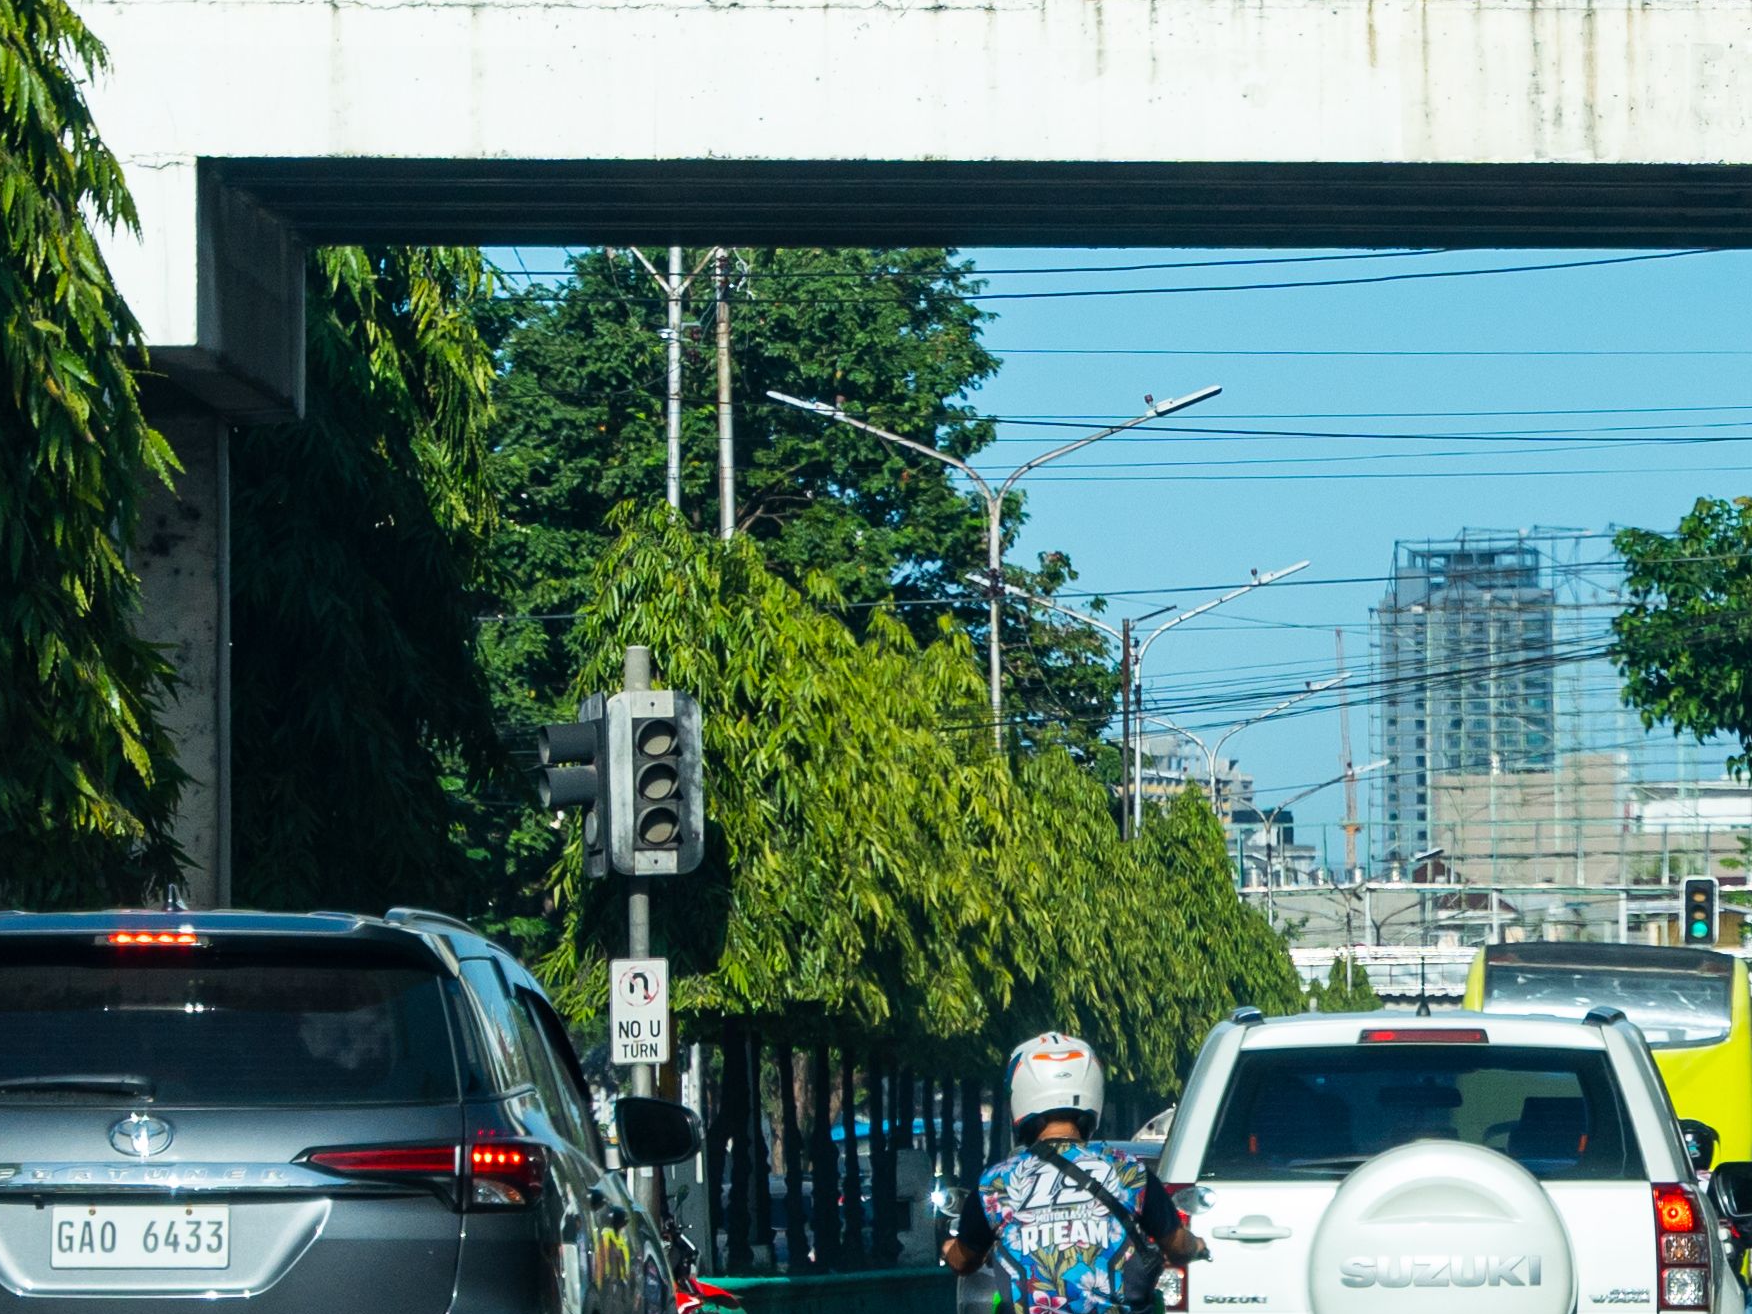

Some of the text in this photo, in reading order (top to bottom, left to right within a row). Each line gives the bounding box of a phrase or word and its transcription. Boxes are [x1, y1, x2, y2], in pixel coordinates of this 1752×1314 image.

[618, 1019, 661, 1040] NO U
[621, 1042, 659, 1059] TURN
[142, 1219, 225, 1255] 6433
[1021, 1220, 1109, 1256] RTEAM
[1339, 1253, 1543, 1289] SUZUKI
[1203, 1293, 1269, 1305] SUZUKI
